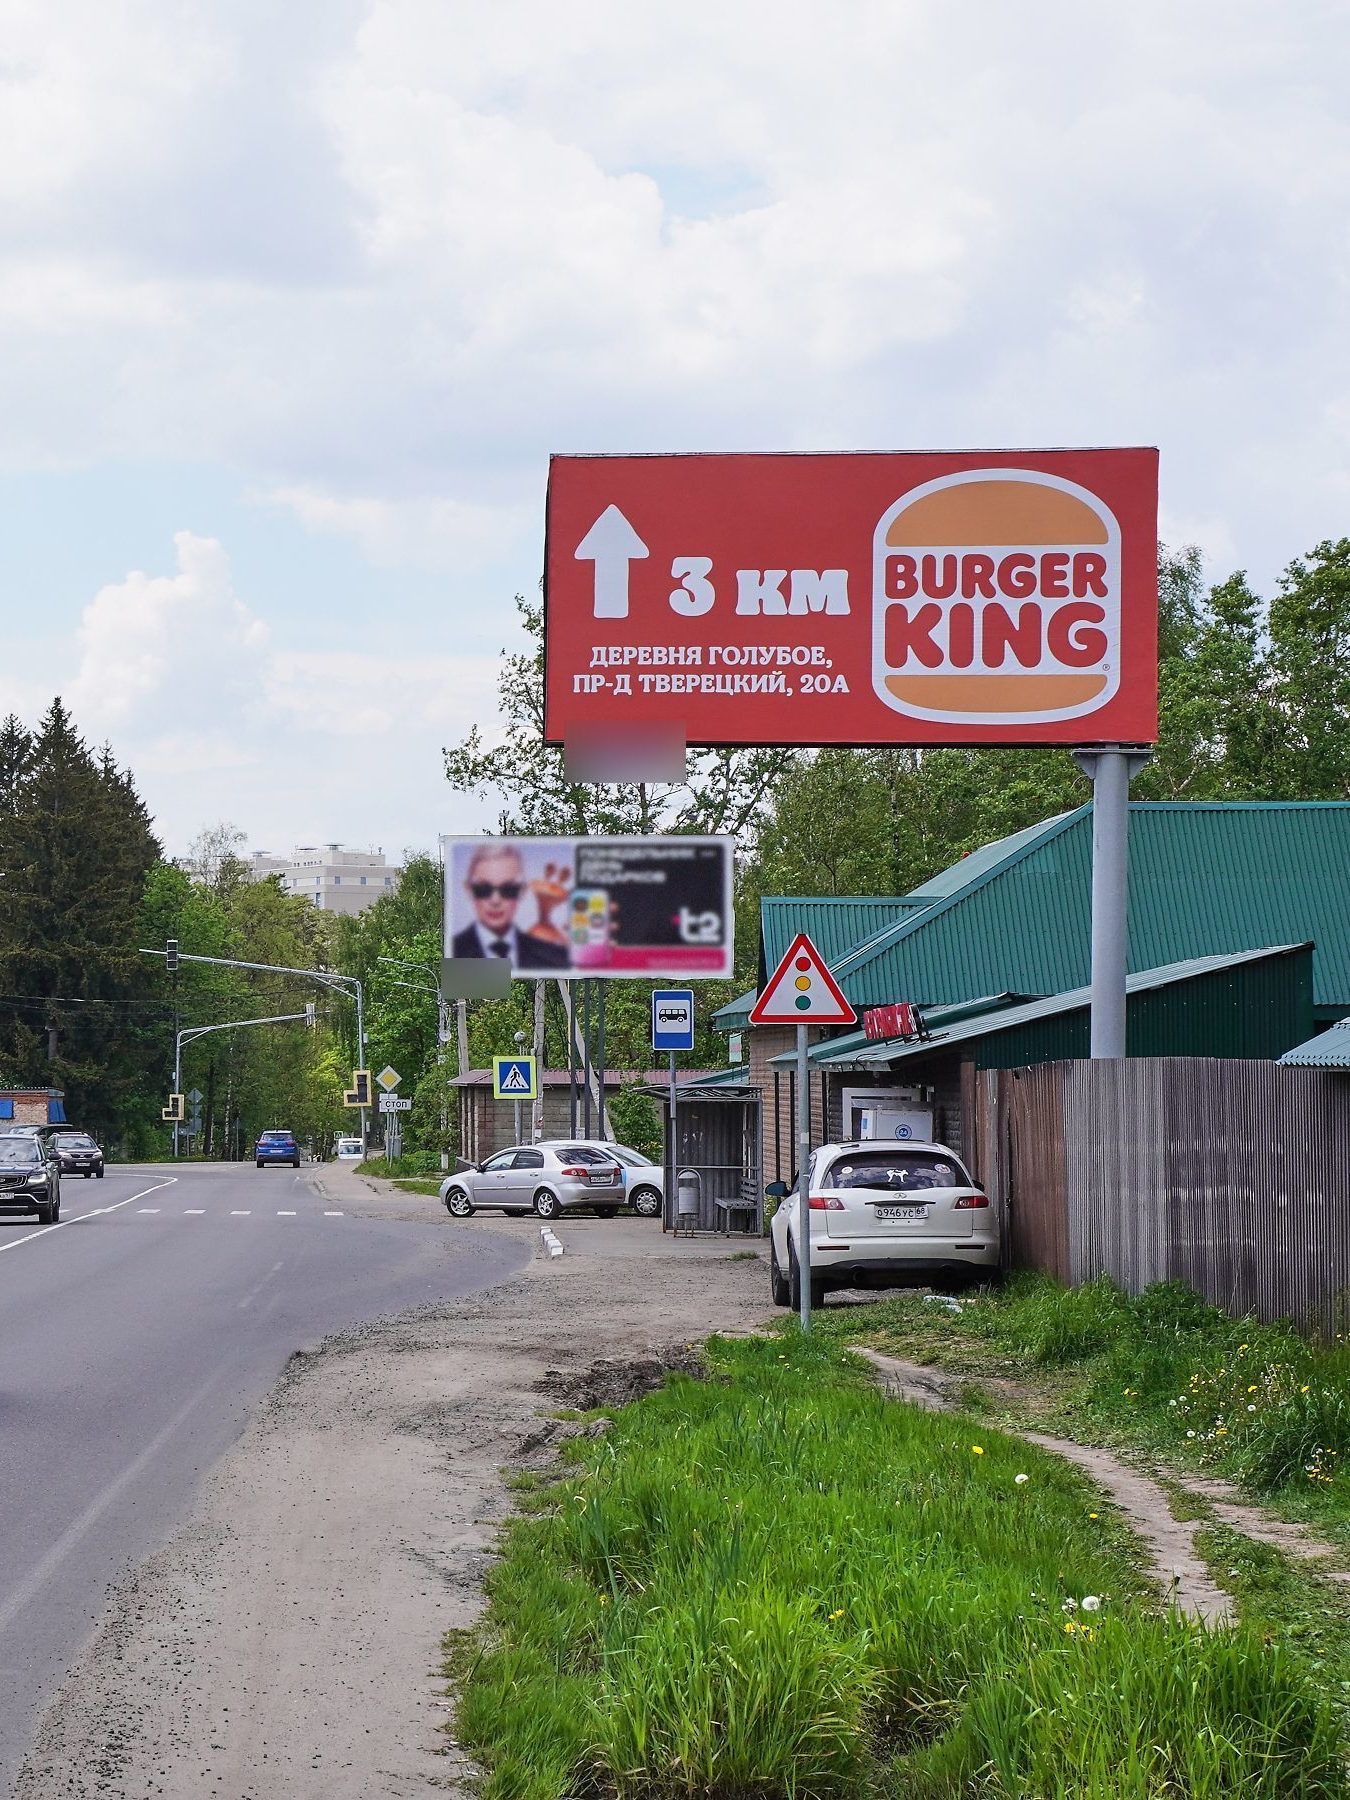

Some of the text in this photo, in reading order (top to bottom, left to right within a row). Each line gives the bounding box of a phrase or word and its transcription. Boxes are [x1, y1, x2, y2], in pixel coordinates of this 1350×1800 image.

[669, 556, 716, 617] 3
[885, 552, 1109, 600] BURGER
[884, 601, 1109, 669] KING
[590, 646, 833, 669] ДЕРЕВНЯ ГОЛУБОЕ,
[573, 674, 632, 696] ПР-Д
[638, 670, 793, 697] ТВЕРЕЦКИЙ,
[385, 1100, 408, 1109] СТОП
